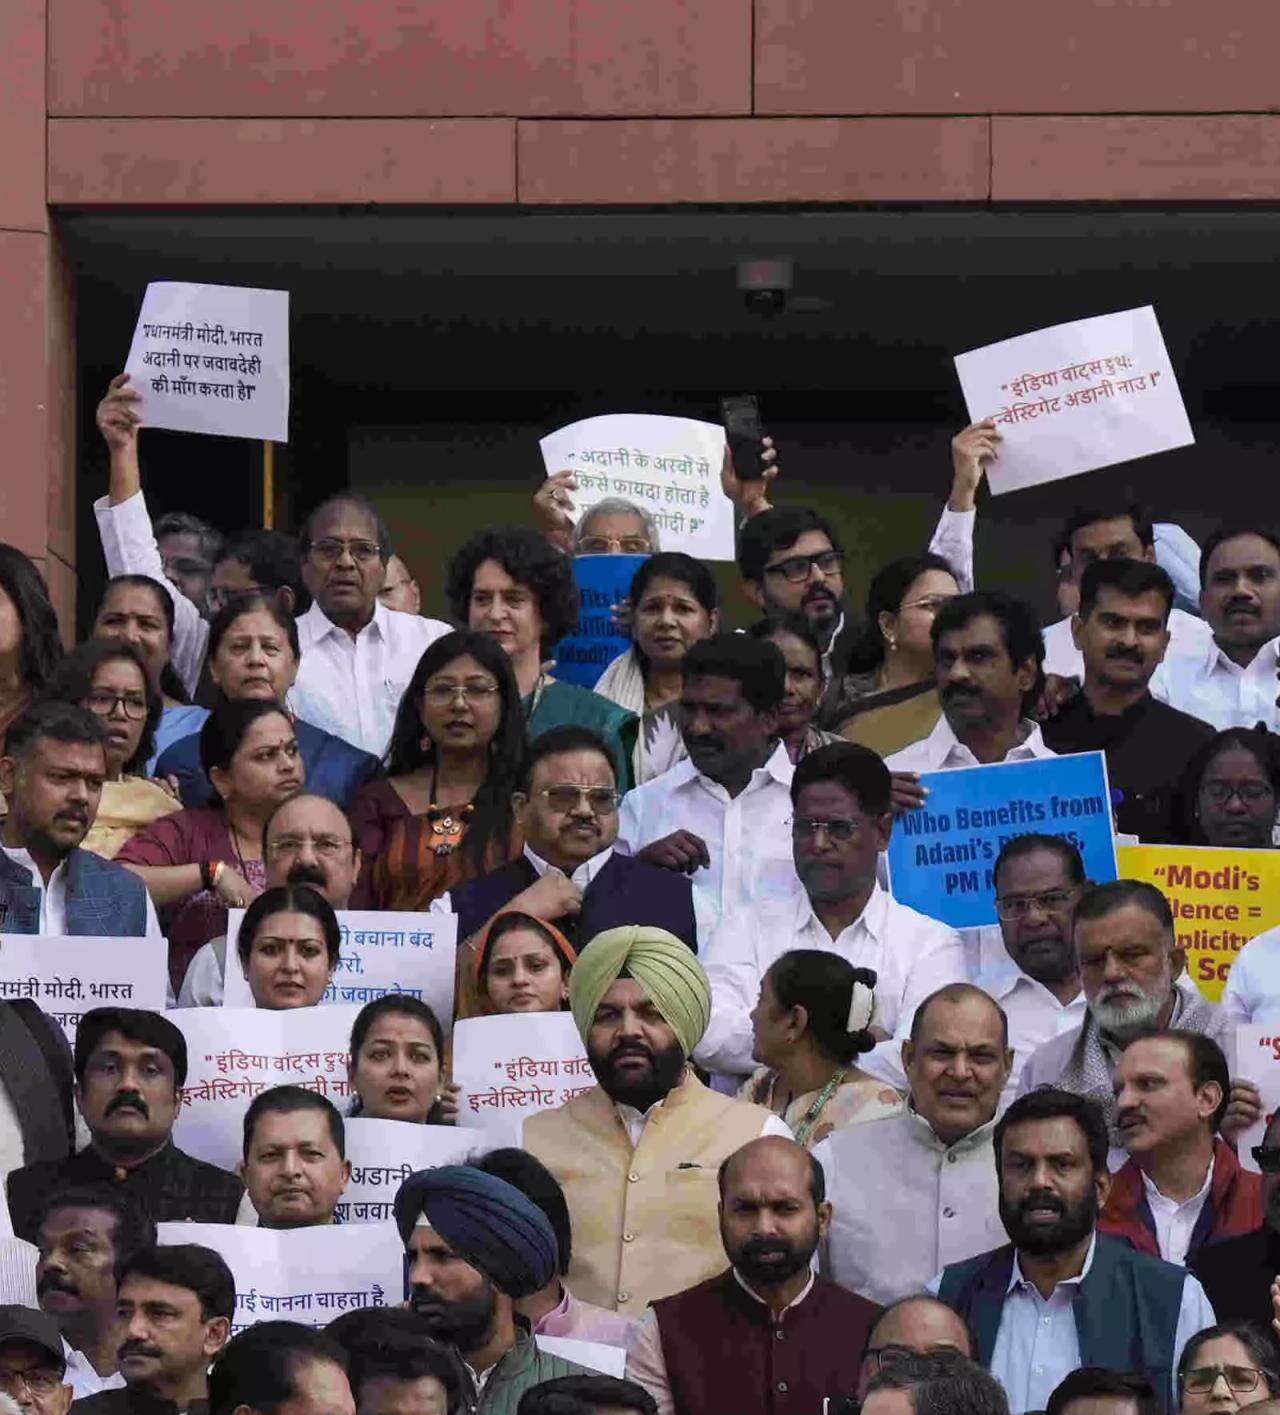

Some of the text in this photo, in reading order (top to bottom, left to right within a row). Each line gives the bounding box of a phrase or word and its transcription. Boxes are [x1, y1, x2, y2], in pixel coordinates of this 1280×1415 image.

[230, 331, 263, 347] भारत
[143, 348, 180, 368] अदानी
[184, 353, 199, 369] पर
[151, 374, 169, 393] की
[198, 382, 234, 400] करता
[1064, 380, 1116, 407] अडानी
[580, 448, 630, 467] अदानी
[633, 449, 651, 468] के
[696, 458, 711, 478] से
[573, 472, 711, 509] किसे फायदा होता है
[955, 799, 1046, 830] Benefits
[1050, 795, 1104, 819] from
[915, 837, 993, 867] Adani’s
[945, 872, 979, 895] PM
[1153, 865, 1260, 891] “Modi’s
[354, 930, 405, 947] बचाना
[408, 928, 435, 949] बंद
[90, 983, 134, 999] भारत
[216, 1049, 269, 1073] इंडिया
[272, 1053, 321, 1073] वांट्स
[505, 1056, 558, 1081] इंडिया
[468, 1084, 556, 1113] इन्वेस्टिगेट
[260, 1294, 313, 1313] जानना
[315, 1291, 369, 1310] चाहता
